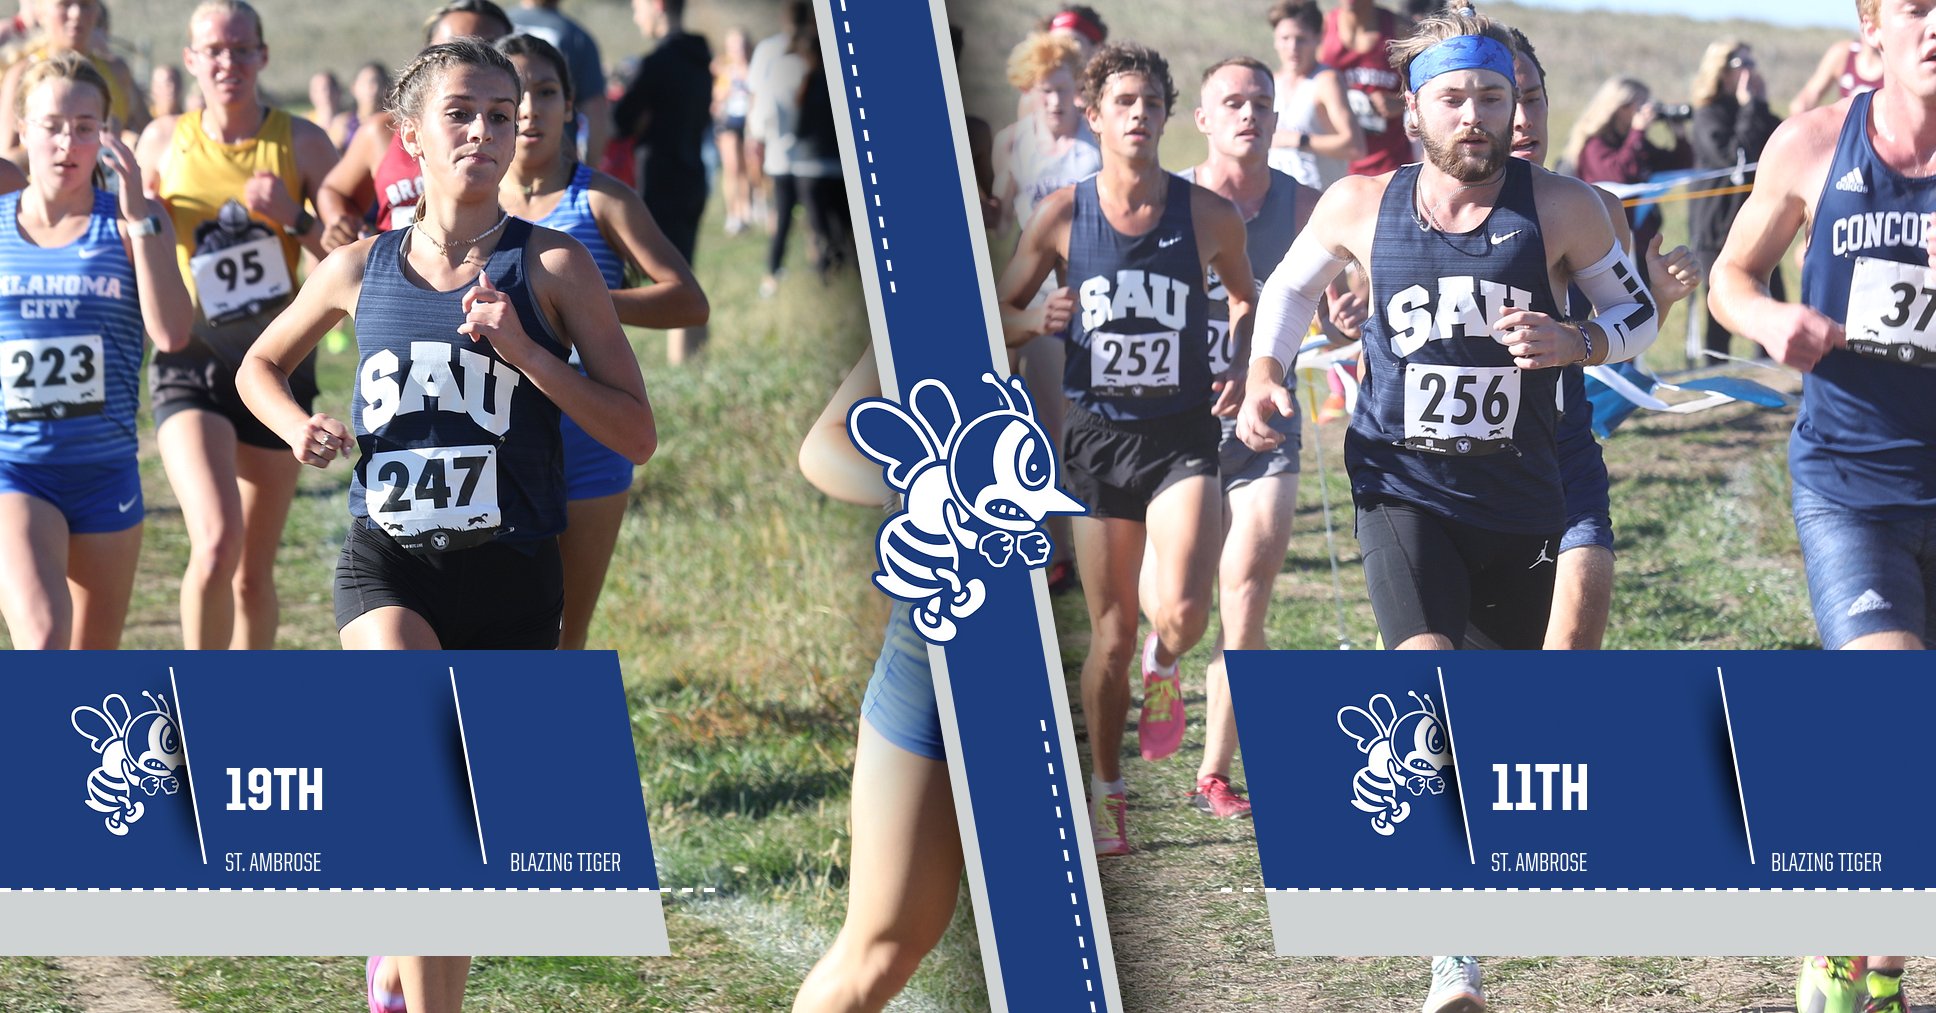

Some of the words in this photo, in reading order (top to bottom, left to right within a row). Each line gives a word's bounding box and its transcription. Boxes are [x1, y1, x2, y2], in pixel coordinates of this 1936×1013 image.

[215, 249, 265, 292] 95
[20, 298, 81, 319] CITY
[1079, 269, 1190, 334] SAU
[11, 344, 96, 389] 223
[1102, 338, 1171, 377] 252
[360, 340, 520, 437] SAU
[1418, 372, 1509, 426] 256
[378, 456, 488, 513] 247
